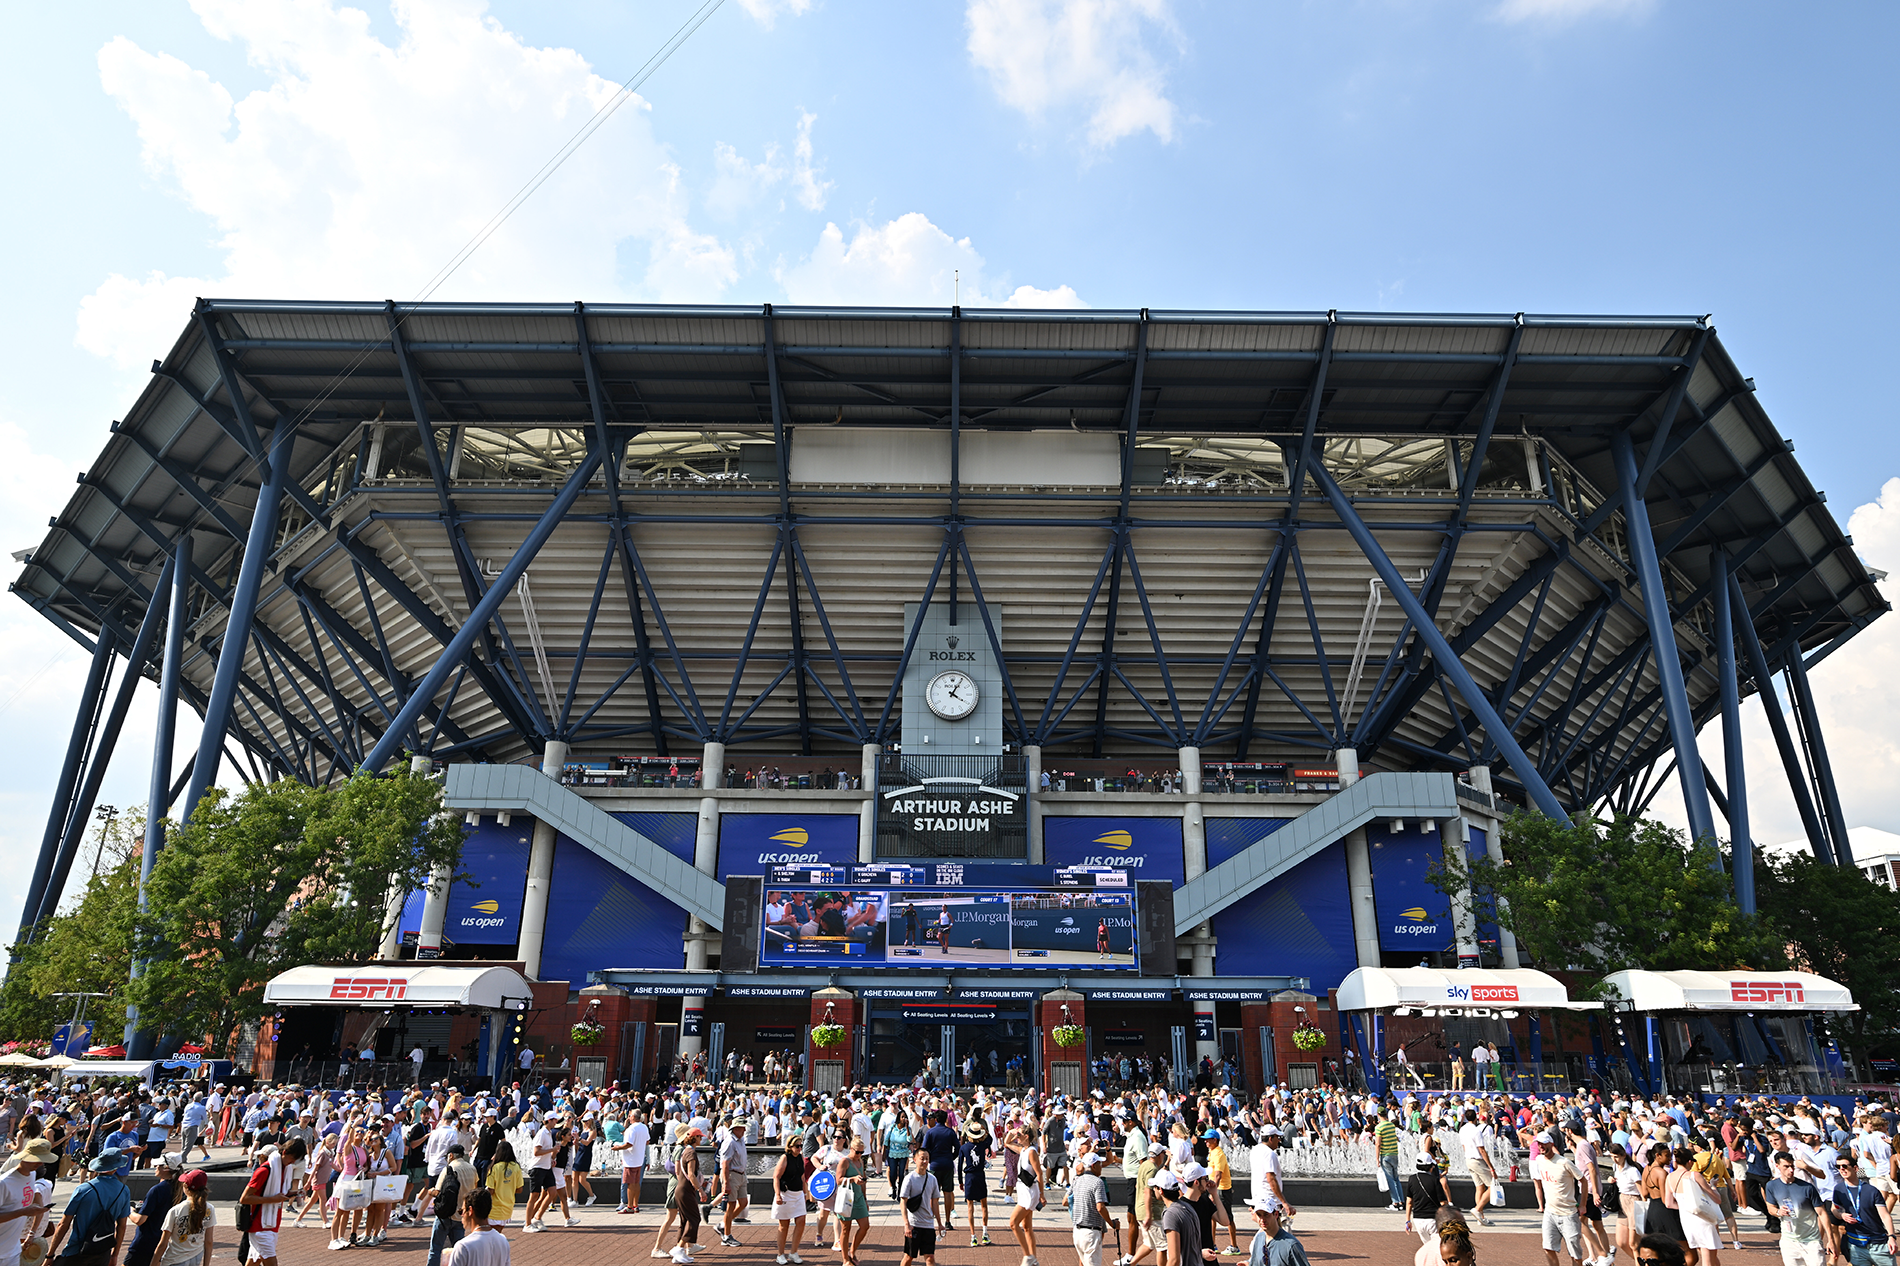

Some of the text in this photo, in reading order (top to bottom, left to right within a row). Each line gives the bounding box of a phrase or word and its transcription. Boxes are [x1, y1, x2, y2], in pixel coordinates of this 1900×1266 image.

[929, 651, 976, 662] ROLEX
[891, 800, 1014, 814] ARTHUR ASHE
[914, 818, 990, 832] STADIUM
[758, 853, 818, 864] us open
[1084, 856, 1144, 867] us open
[936, 873, 963, 884] IBM
[461, 918, 504, 928] us open
[955, 911, 1009, 925] J.P.Morgan
[1103, 918, 1132, 927] J.P.Mo
[1394, 926, 1436, 936] us open
[330, 978, 408, 998] ESPN
[1447, 985, 1517, 1000] sky sports
[1731, 982, 1804, 1002] ESPN
